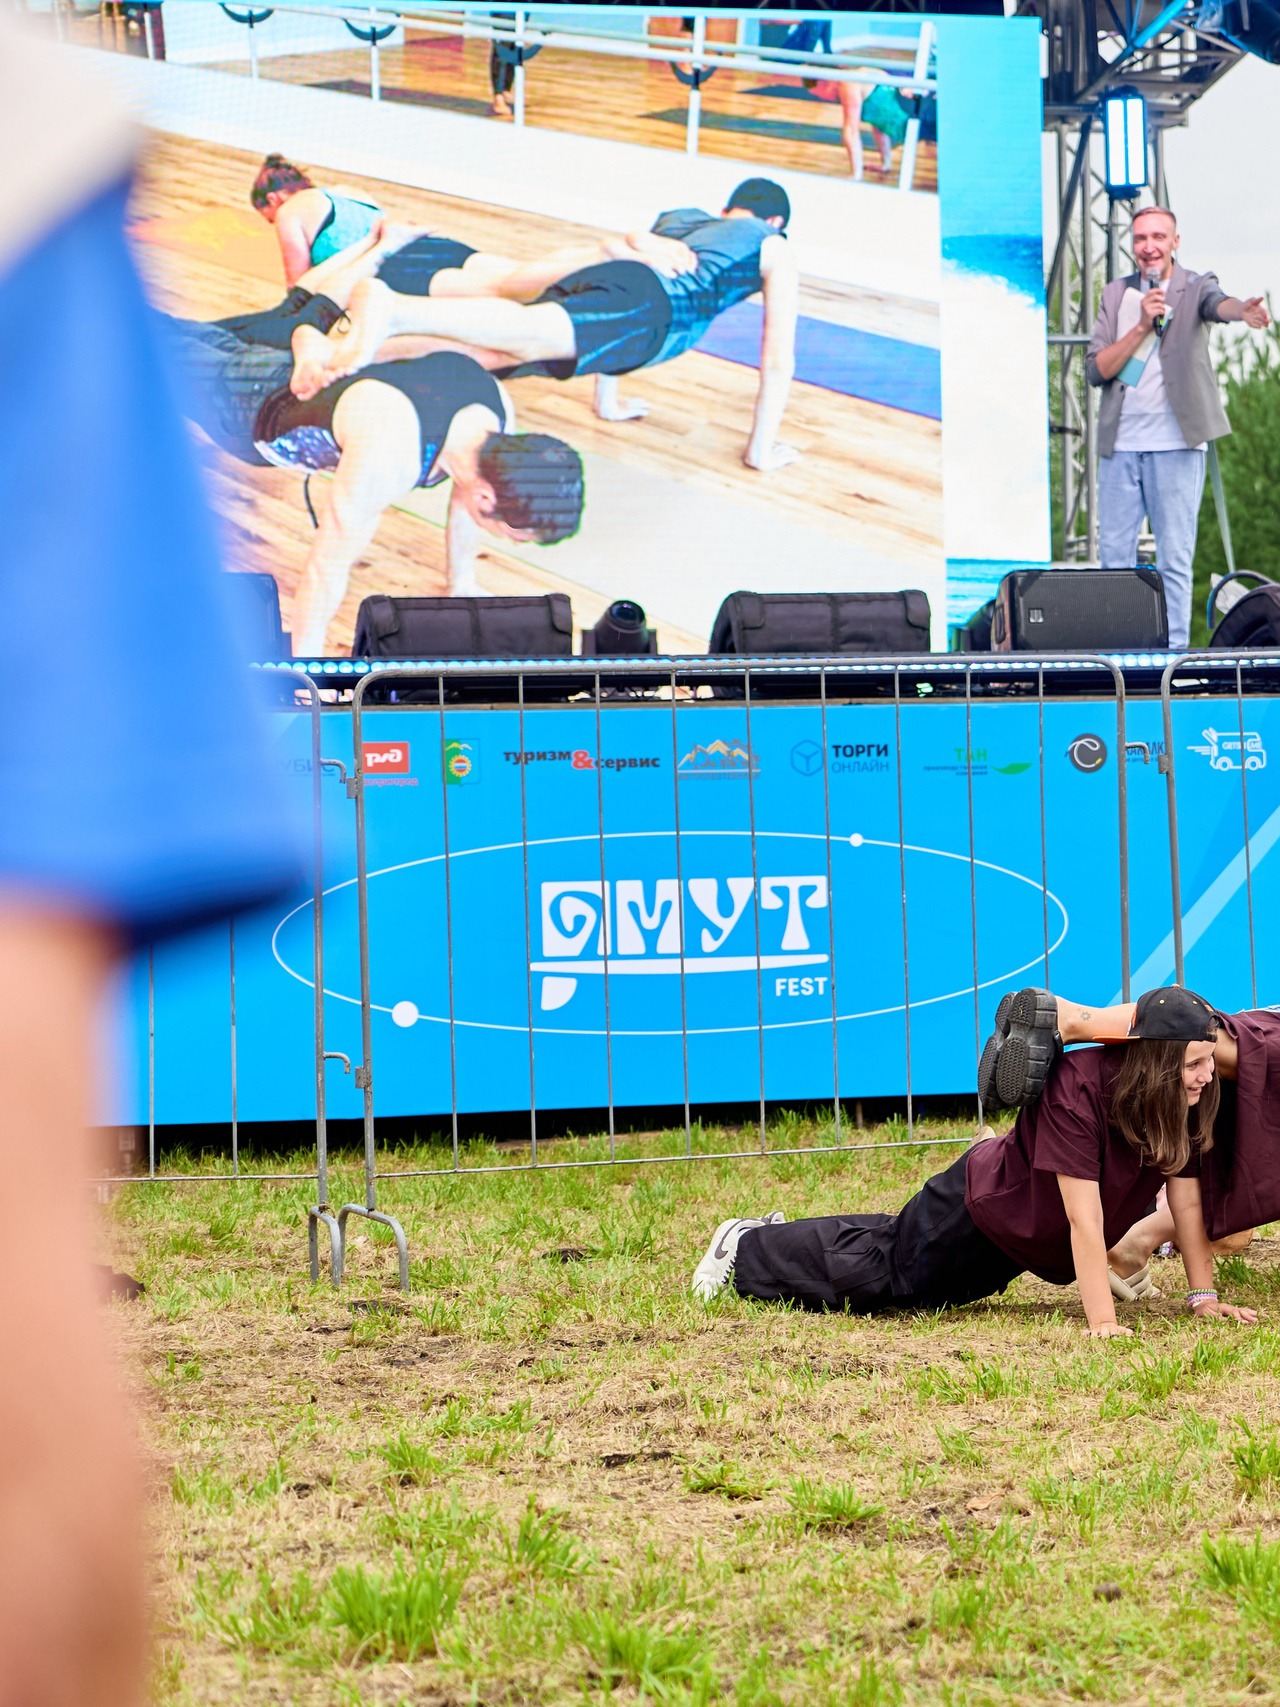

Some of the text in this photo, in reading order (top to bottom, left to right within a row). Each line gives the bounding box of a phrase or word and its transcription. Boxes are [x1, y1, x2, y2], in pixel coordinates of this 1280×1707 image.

[832, 744, 888, 758] ТОРГИ
[953, 747, 987, 762] ТАН
[831, 760, 889, 773] ОНЛАЙН
[775, 976, 828, 996] FEST
